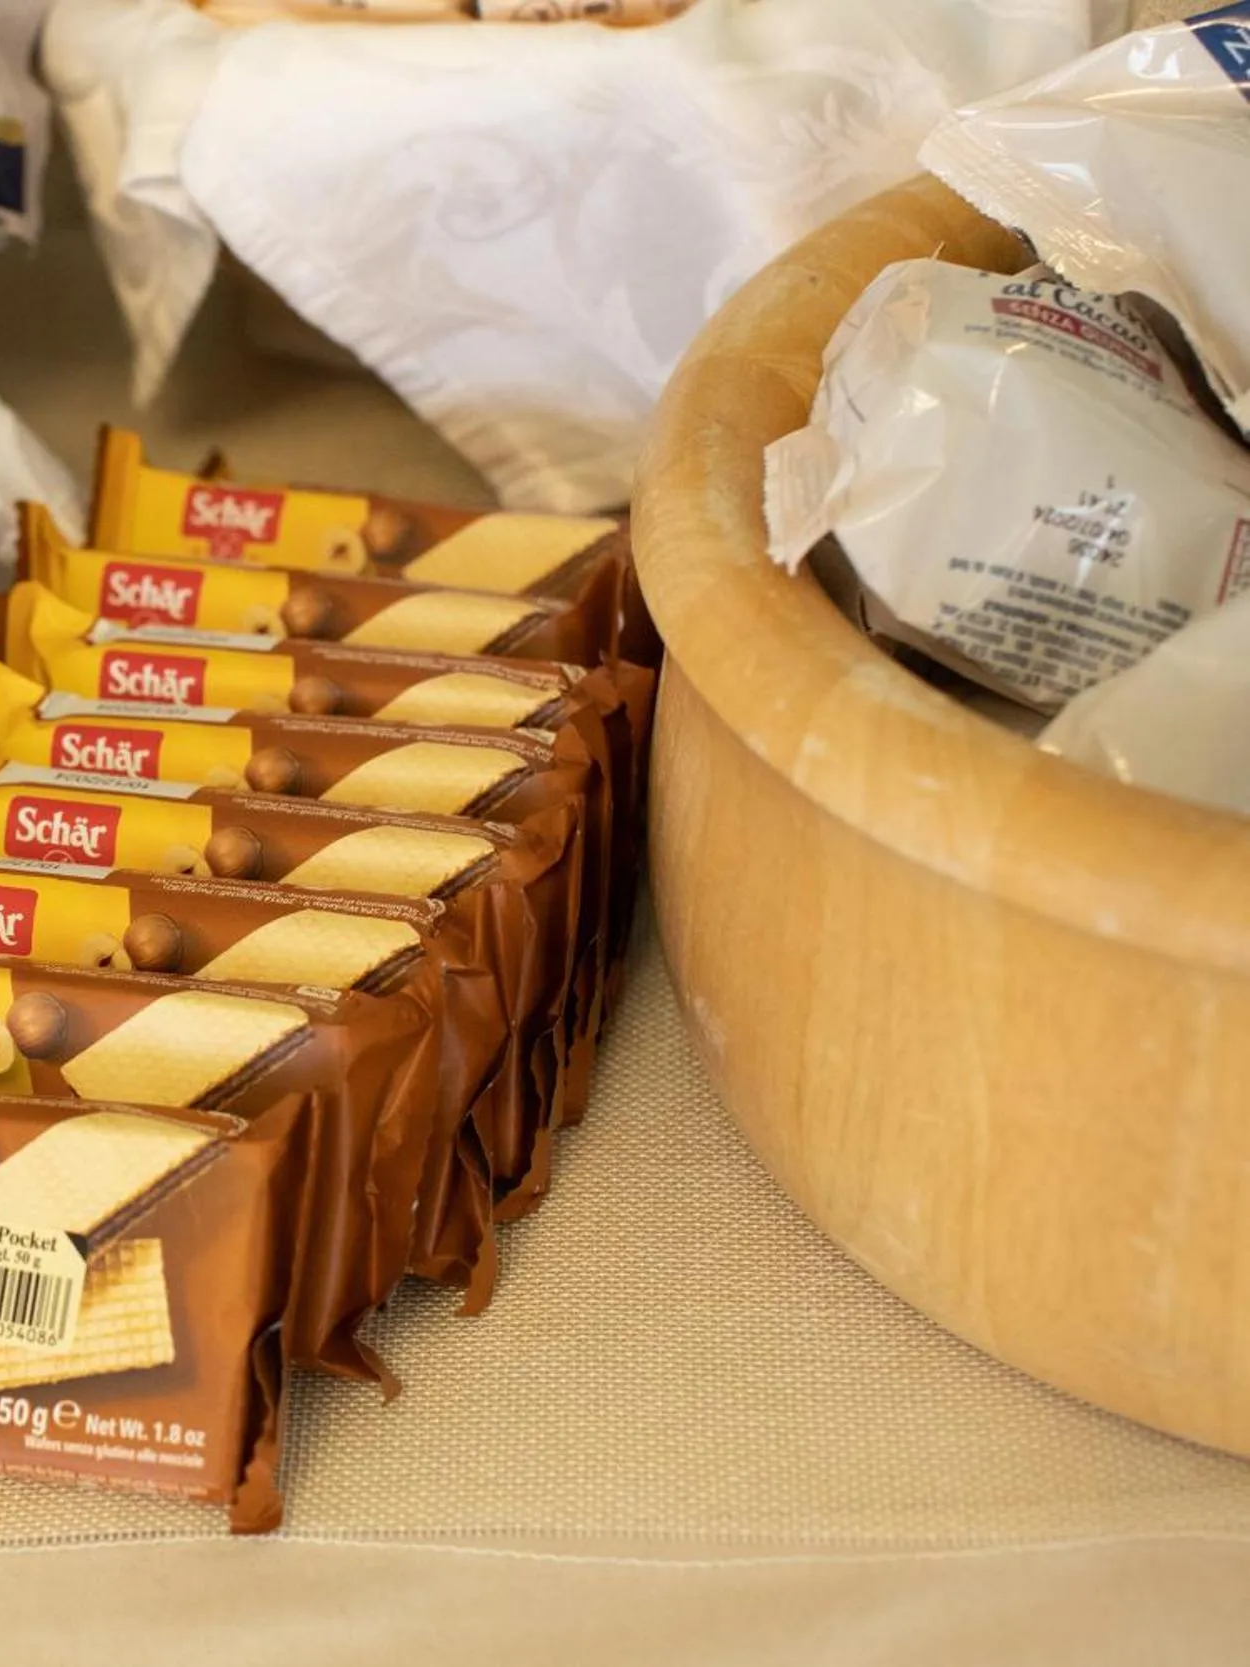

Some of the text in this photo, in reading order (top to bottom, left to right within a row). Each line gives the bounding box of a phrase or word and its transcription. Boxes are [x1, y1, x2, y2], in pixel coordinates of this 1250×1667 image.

[1053, 287, 1147, 351] Cacao
[188, 492, 275, 539] Schär
[107, 571, 194, 620] Schär
[107, 658, 196, 703] Schär
[60, 731, 151, 777] Schär
[15, 806, 107, 858] Schär
[14, 1249, 31, 1265] 50
[33, 1255, 42, 1269] g
[32, 1406, 48, 1436] g
[85, 1414, 116, 1437] Net
[119, 1418, 148, 1441] Wt.
[153, 1421, 181, 1446] 1.8
[184, 1428, 206, 1448] oz
